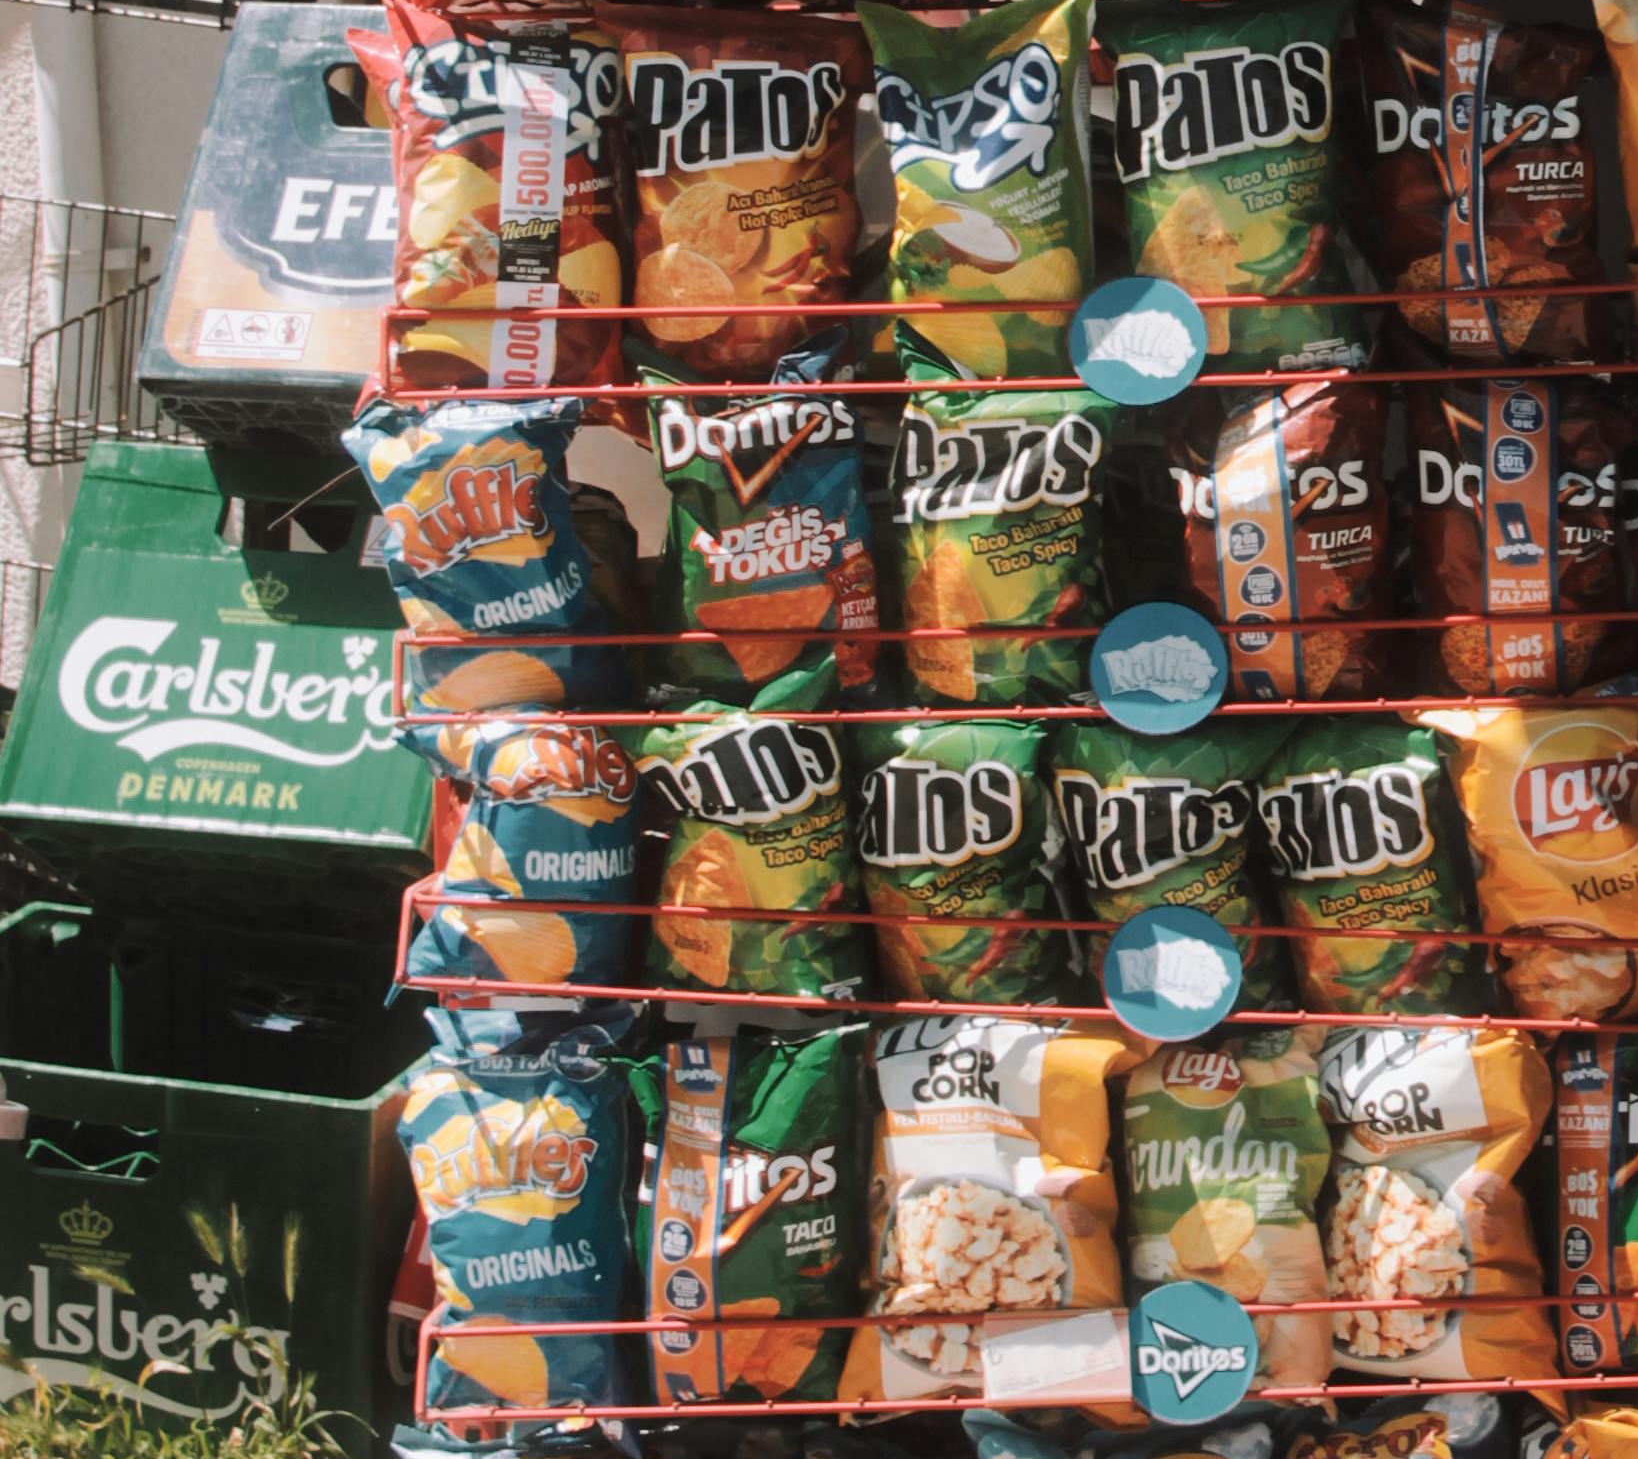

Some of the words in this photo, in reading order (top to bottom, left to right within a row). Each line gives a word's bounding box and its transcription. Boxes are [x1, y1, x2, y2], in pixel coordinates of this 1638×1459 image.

[1223, 173, 1262, 193] Taco
[1516, 161, 1584, 181] TURCA
[271, 177, 398, 243] EFE
[1243, 190, 1283, 213] Taco
[500, 218, 559, 240] Hediye
[660, 400, 855, 470] Doritos
[720, 506, 823, 555] DEĞİŞ
[970, 533, 1008, 555] Taco
[1012, 508, 1083, 545] Baharatlı
[1308, 526, 1373, 552] TURCA
[708, 534, 832, 583] TOKUŞ
[990, 554, 1031, 576] Taco
[1034, 535, 1080, 564] Spicy
[474, 562, 582, 630] ORIGINALS
[1491, 589, 1548, 604] KAZAN!
[175, 757, 261, 774] COPENHAGEN
[117, 772, 303, 810] DENMARK
[762, 846, 806, 868] Taco
[1164, 886, 1204, 907] Taco
[1382, 896, 1430, 925] Spicy
[929, 1047, 996, 1075] POP
[912, 1074, 999, 1106] CORN
[412, 1117, 598, 1221] Ruffles
[725, 1147, 836, 1212] ritos
[1568, 1198, 1599, 1220] YOK
[783, 1215, 835, 1244] TACO
[467, 1238, 598, 1289] ORIGINALS
[0, 1265, 291, 1405] rlsberg
[1138, 1345, 1246, 1376] Doritos
